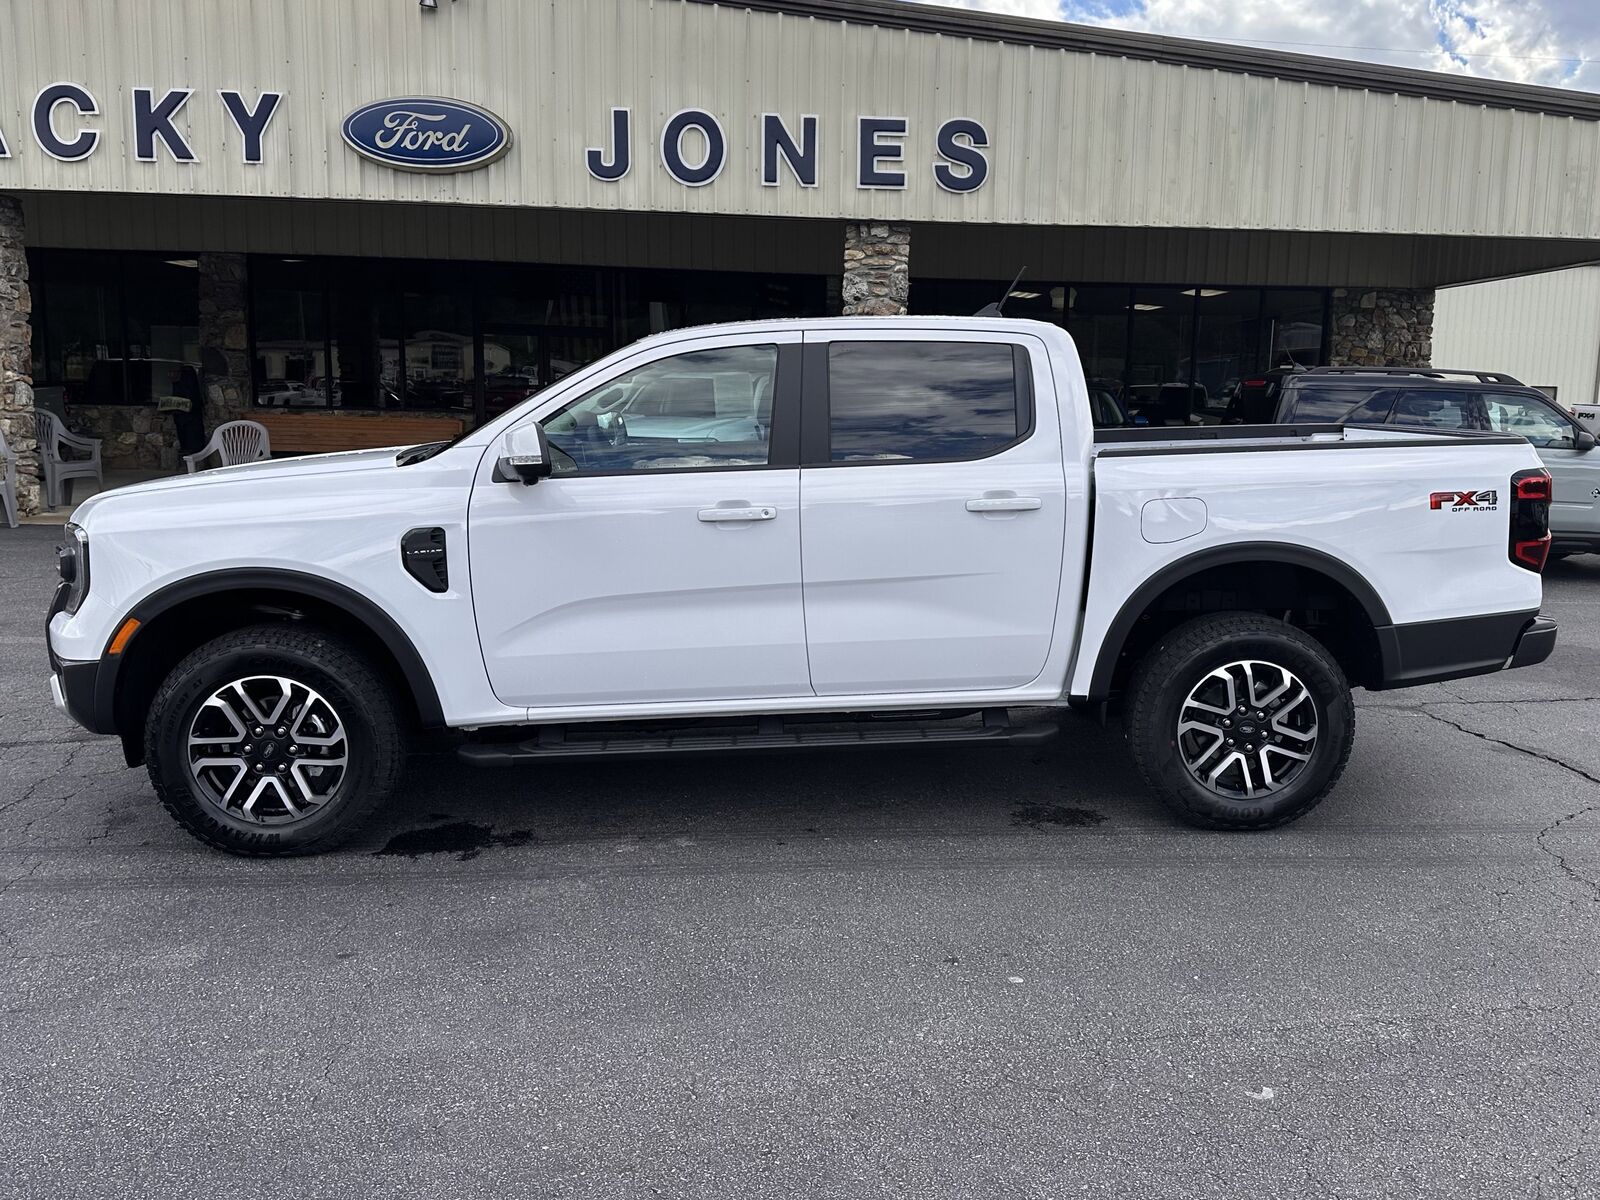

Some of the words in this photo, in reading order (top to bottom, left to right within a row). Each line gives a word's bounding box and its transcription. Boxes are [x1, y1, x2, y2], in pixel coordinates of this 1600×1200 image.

[0, 82, 283, 163] CKY
[588, 107, 990, 193] JONES
[375, 110, 471, 154] Ford
[1429, 490, 1497, 510] FX4
